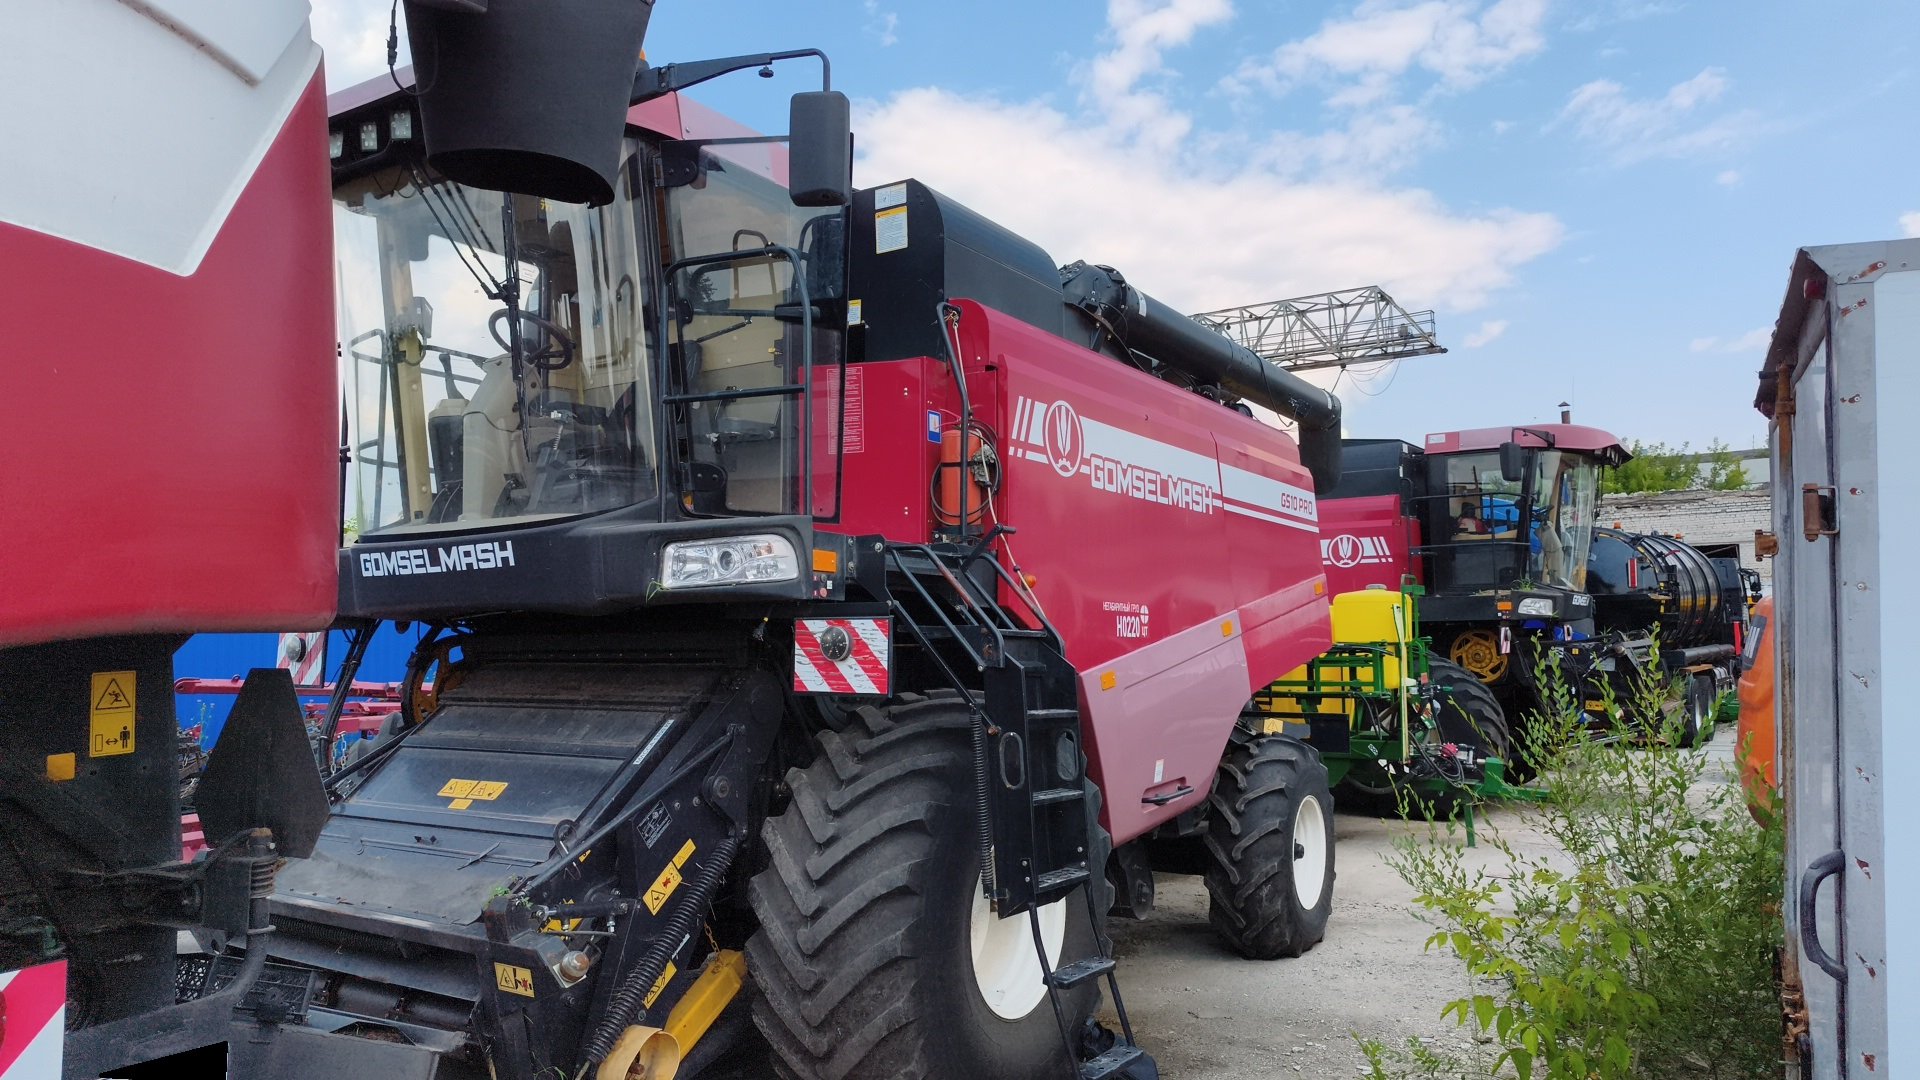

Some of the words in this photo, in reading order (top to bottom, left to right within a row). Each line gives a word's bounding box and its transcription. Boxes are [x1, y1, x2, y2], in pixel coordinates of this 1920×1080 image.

[1090, 456, 1213, 515] GOMSELMASH
[1280, 492, 1298, 511] GS10
[1298, 498, 1313, 516] PRO
[360, 540, 515, 577] GOMSELMASH
